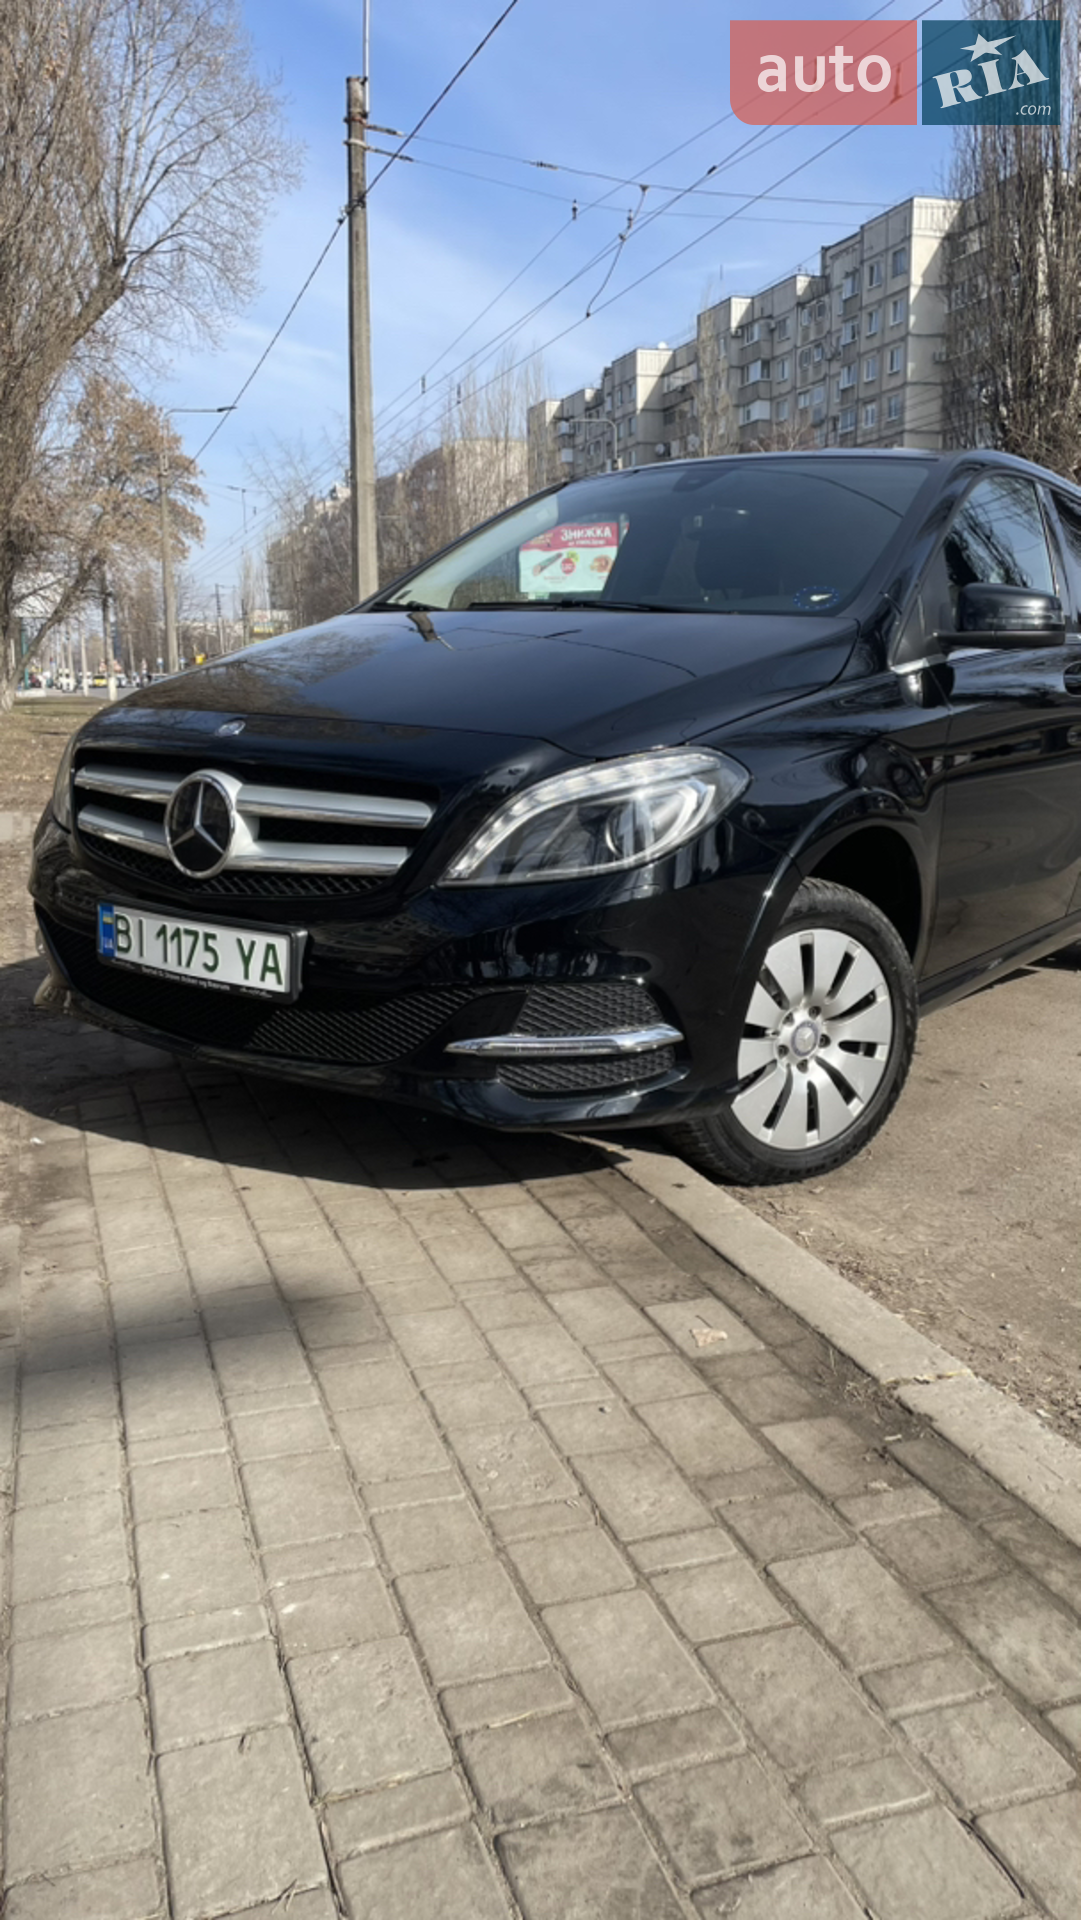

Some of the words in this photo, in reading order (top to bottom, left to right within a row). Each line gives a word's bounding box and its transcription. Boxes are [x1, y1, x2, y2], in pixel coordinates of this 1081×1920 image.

[561, 526, 612, 541] ЗНИЖКА
[115, 913, 146, 958] BI
[155, 924, 219, 973] 1175
[236, 937, 283, 986] YA
